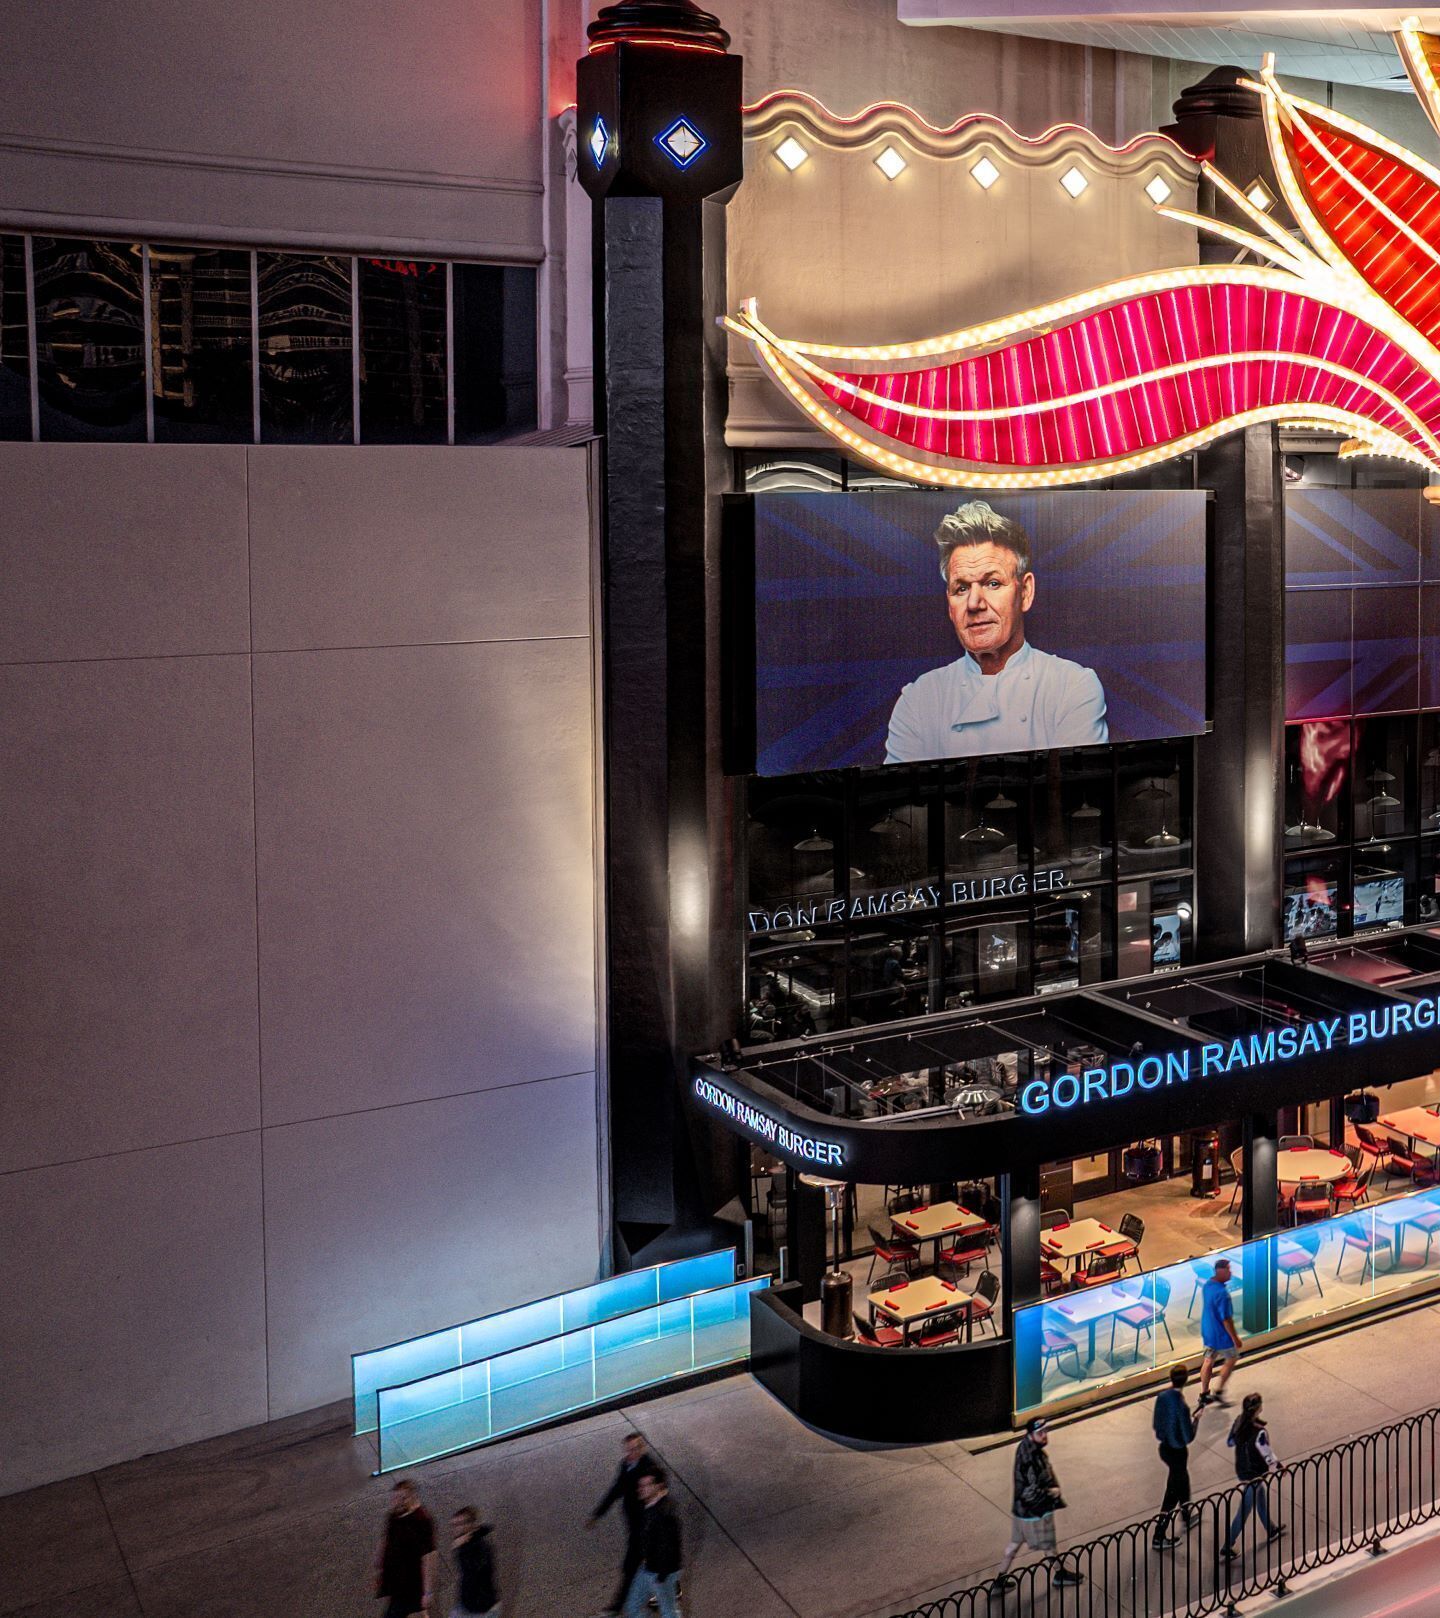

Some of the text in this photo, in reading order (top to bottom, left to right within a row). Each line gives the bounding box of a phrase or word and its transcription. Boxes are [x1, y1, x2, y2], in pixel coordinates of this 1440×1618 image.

[827, 886, 941, 922] RAMSAY
[953, 869, 1065, 903] BURGER
[1021, 1049, 1190, 1115] GORDON
[1201, 1018, 1341, 1077] RAMSAY
[695, 1078, 844, 1166] GORDON RAMSAY BURGER
